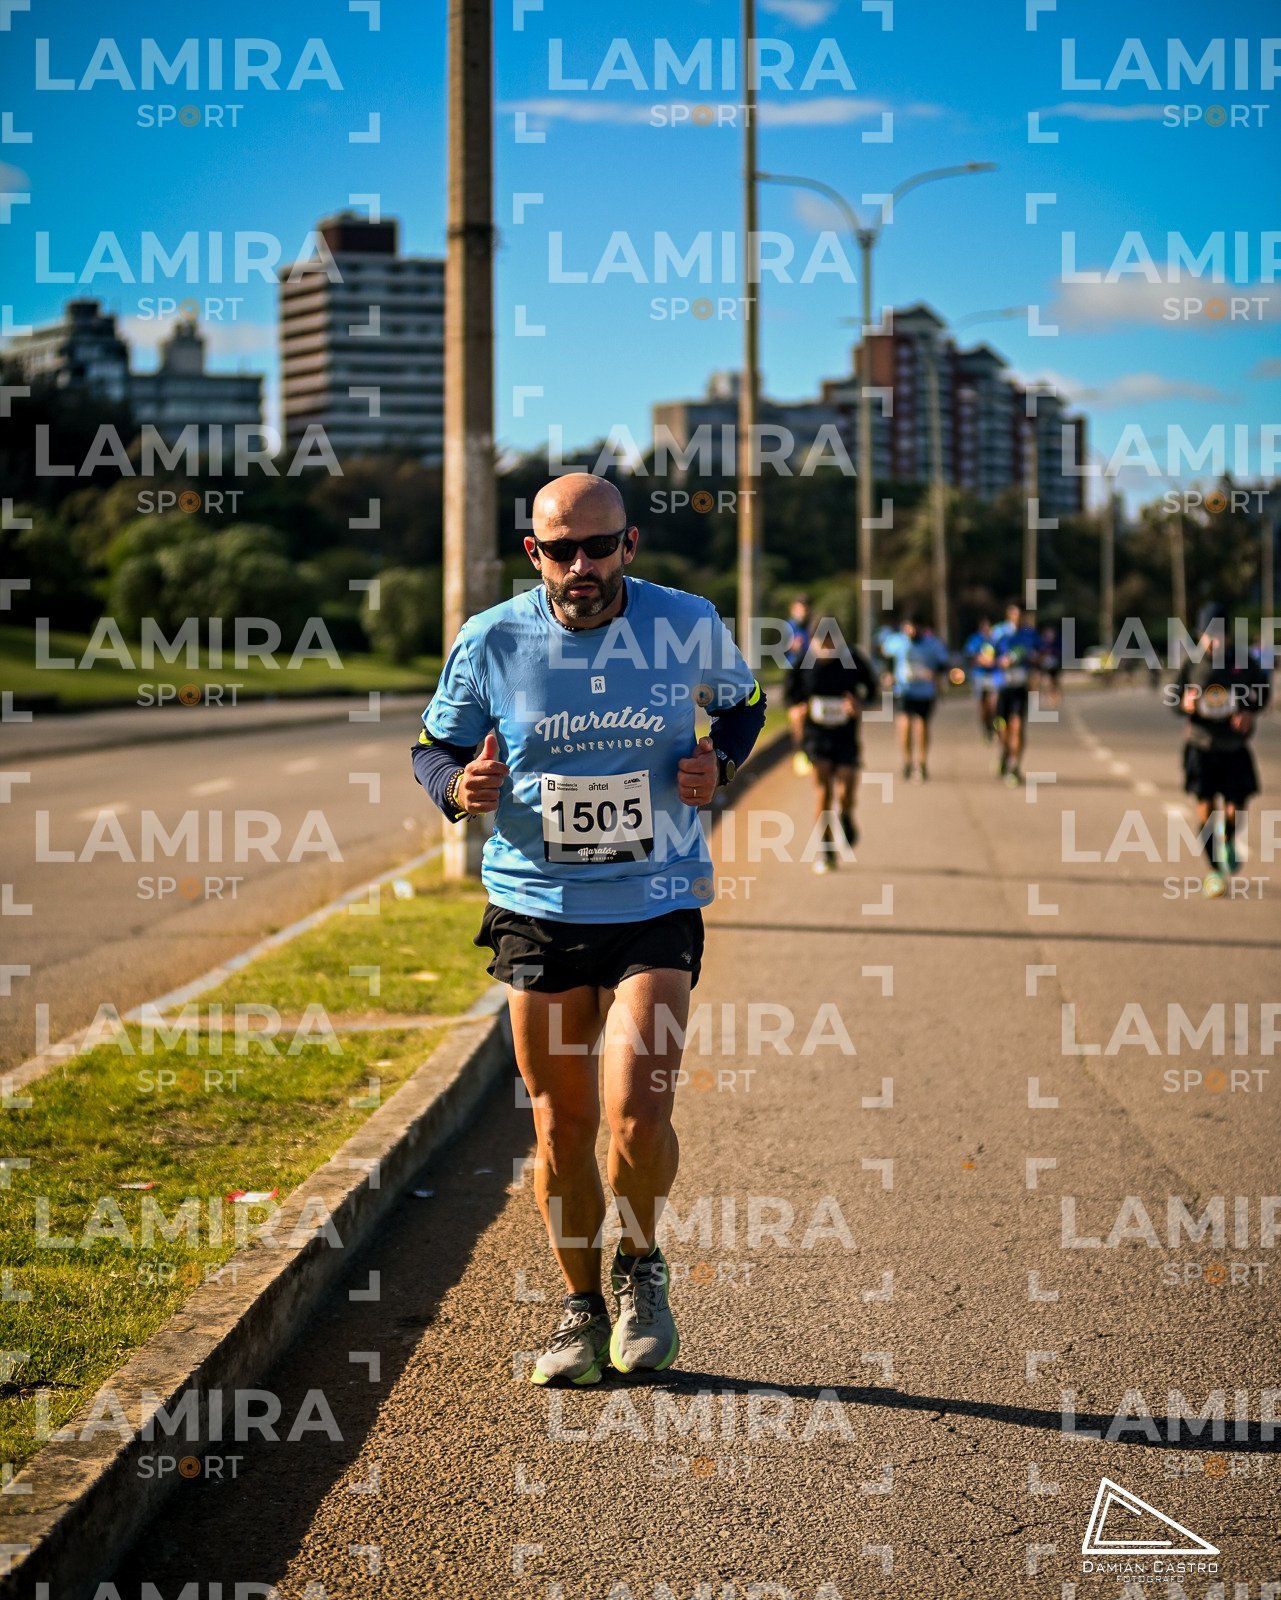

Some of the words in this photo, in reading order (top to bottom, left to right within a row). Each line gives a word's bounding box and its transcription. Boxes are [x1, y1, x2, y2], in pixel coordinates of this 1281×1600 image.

[534, 706, 666, 742] Maratón
[550, 737, 655, 755] MONTEVIDEO
[588, 782, 609, 791] antel
[551, 797, 643, 833] 1505
